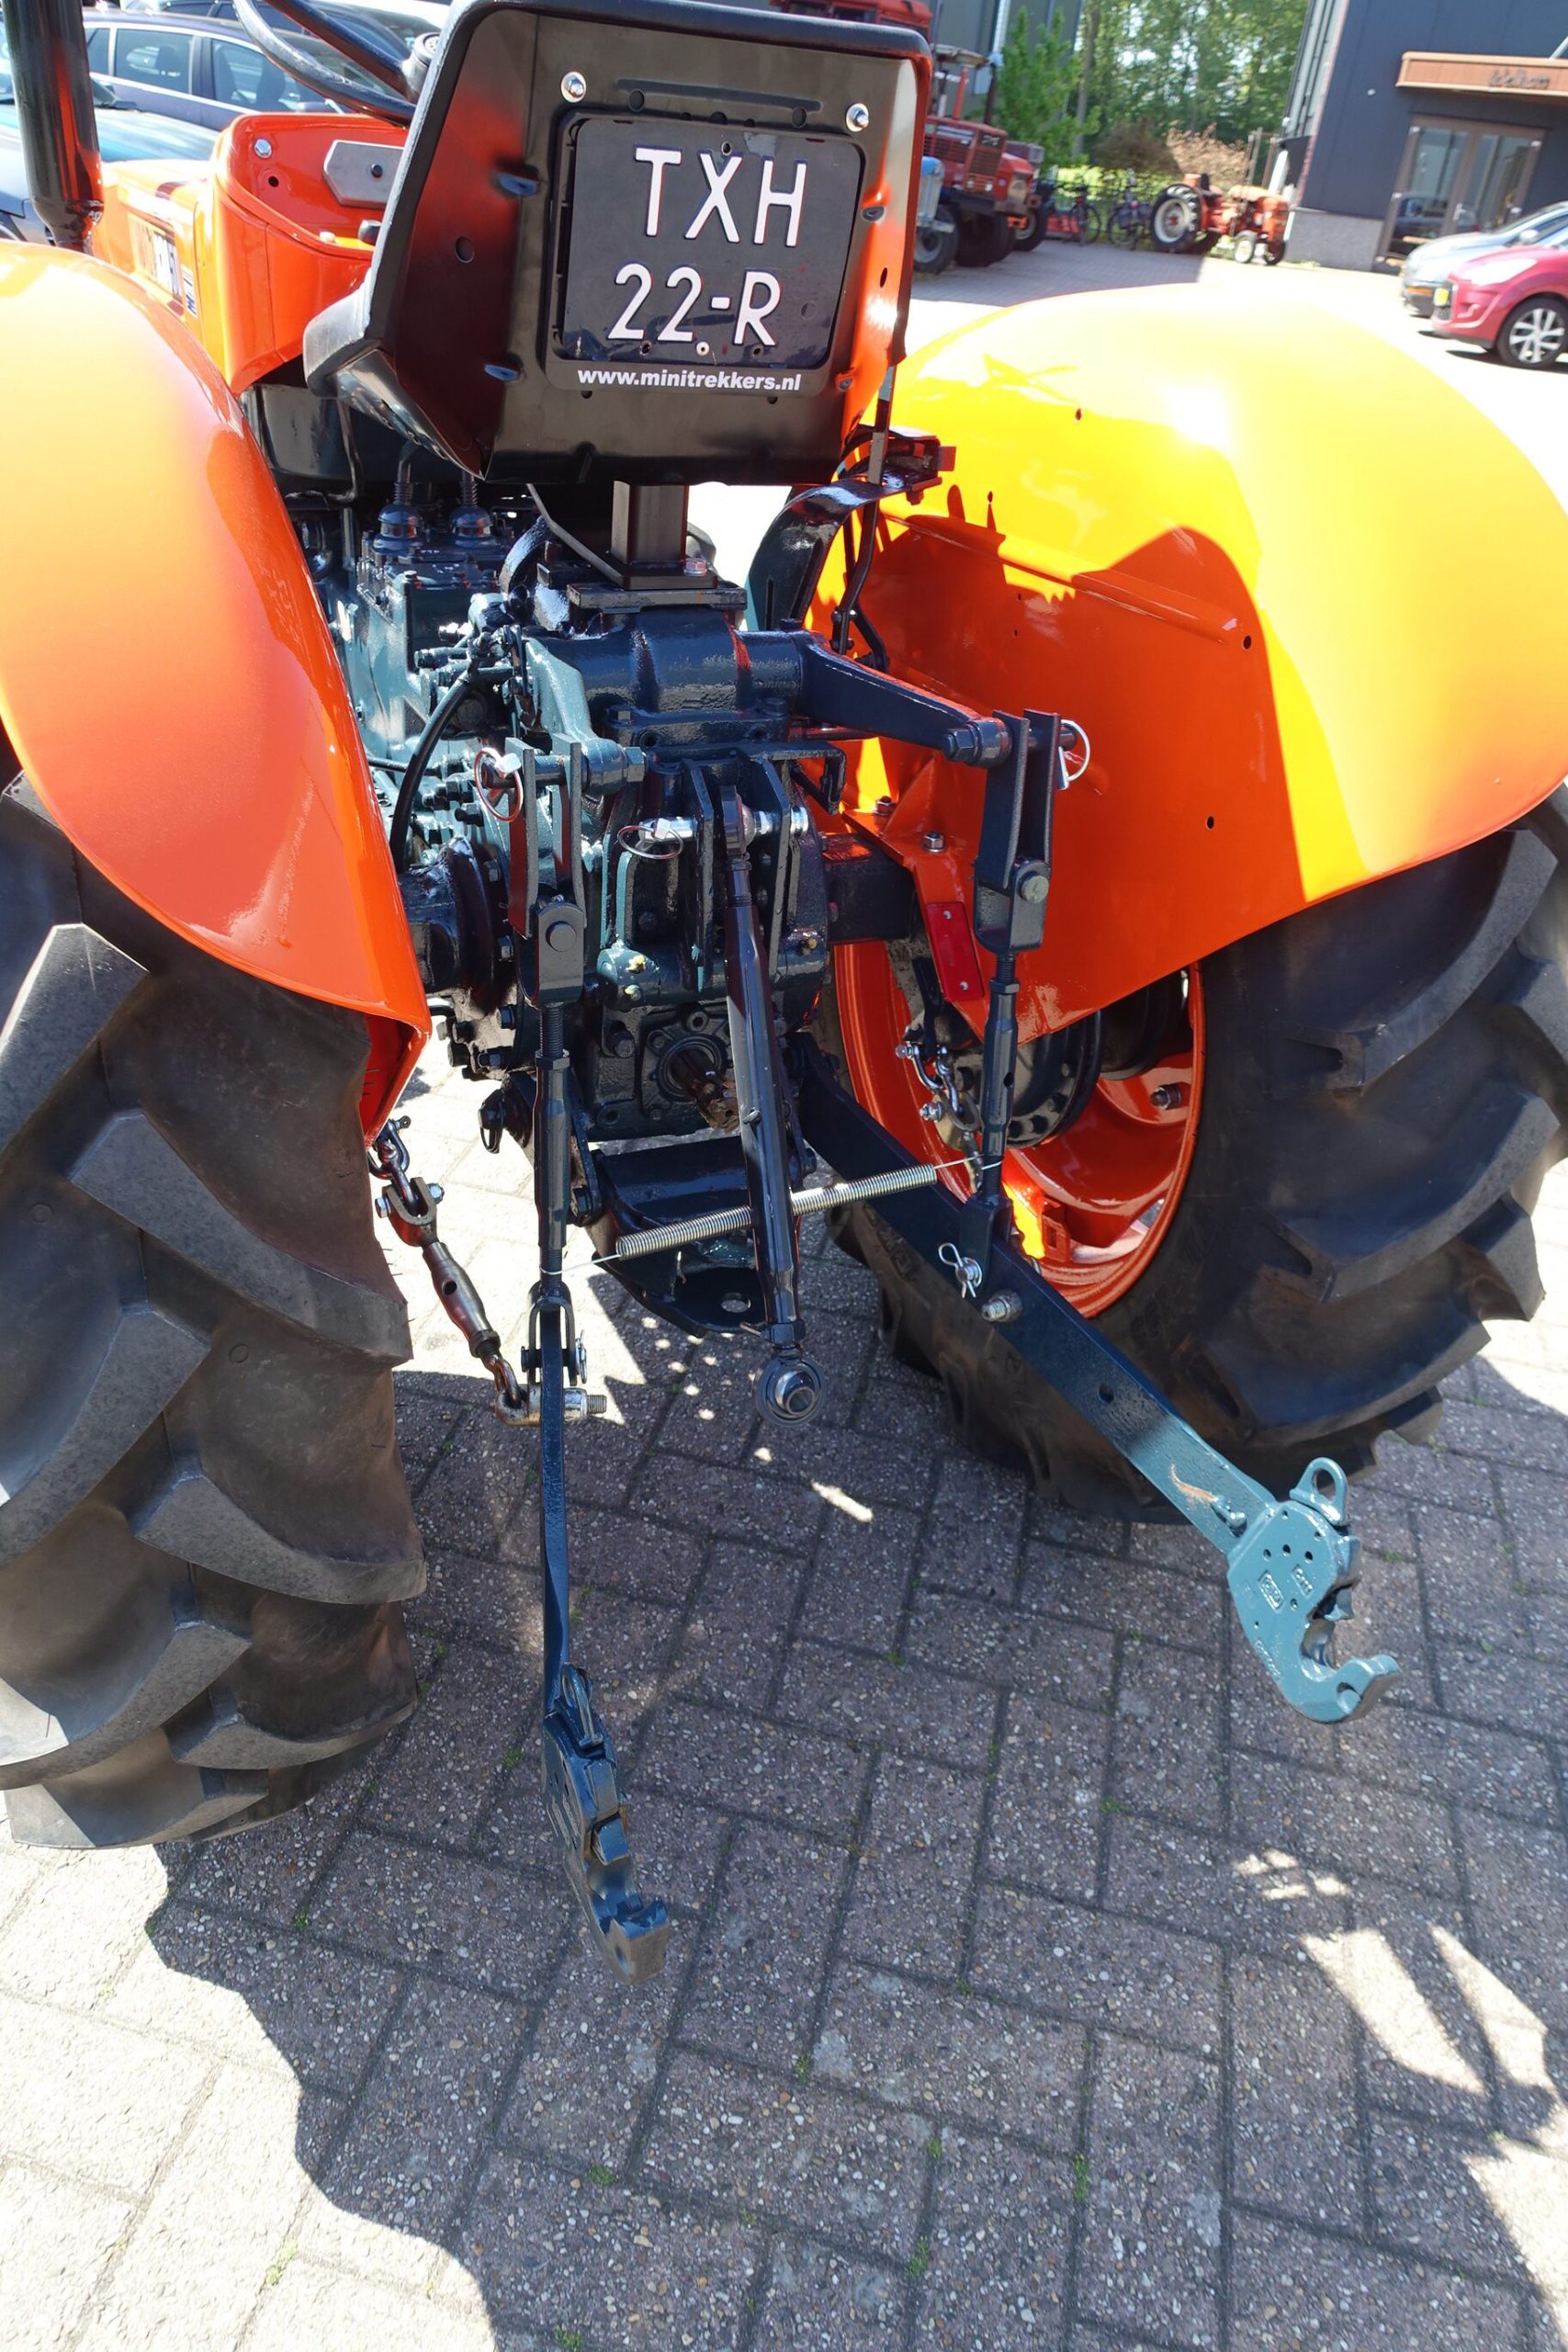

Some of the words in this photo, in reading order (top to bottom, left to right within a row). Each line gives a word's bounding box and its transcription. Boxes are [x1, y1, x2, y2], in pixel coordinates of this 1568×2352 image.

[635, 147, 807, 247] TXH
[607, 263, 782, 346] 22-R
[577, 369, 802, 391] www.minitrekkers.nl
